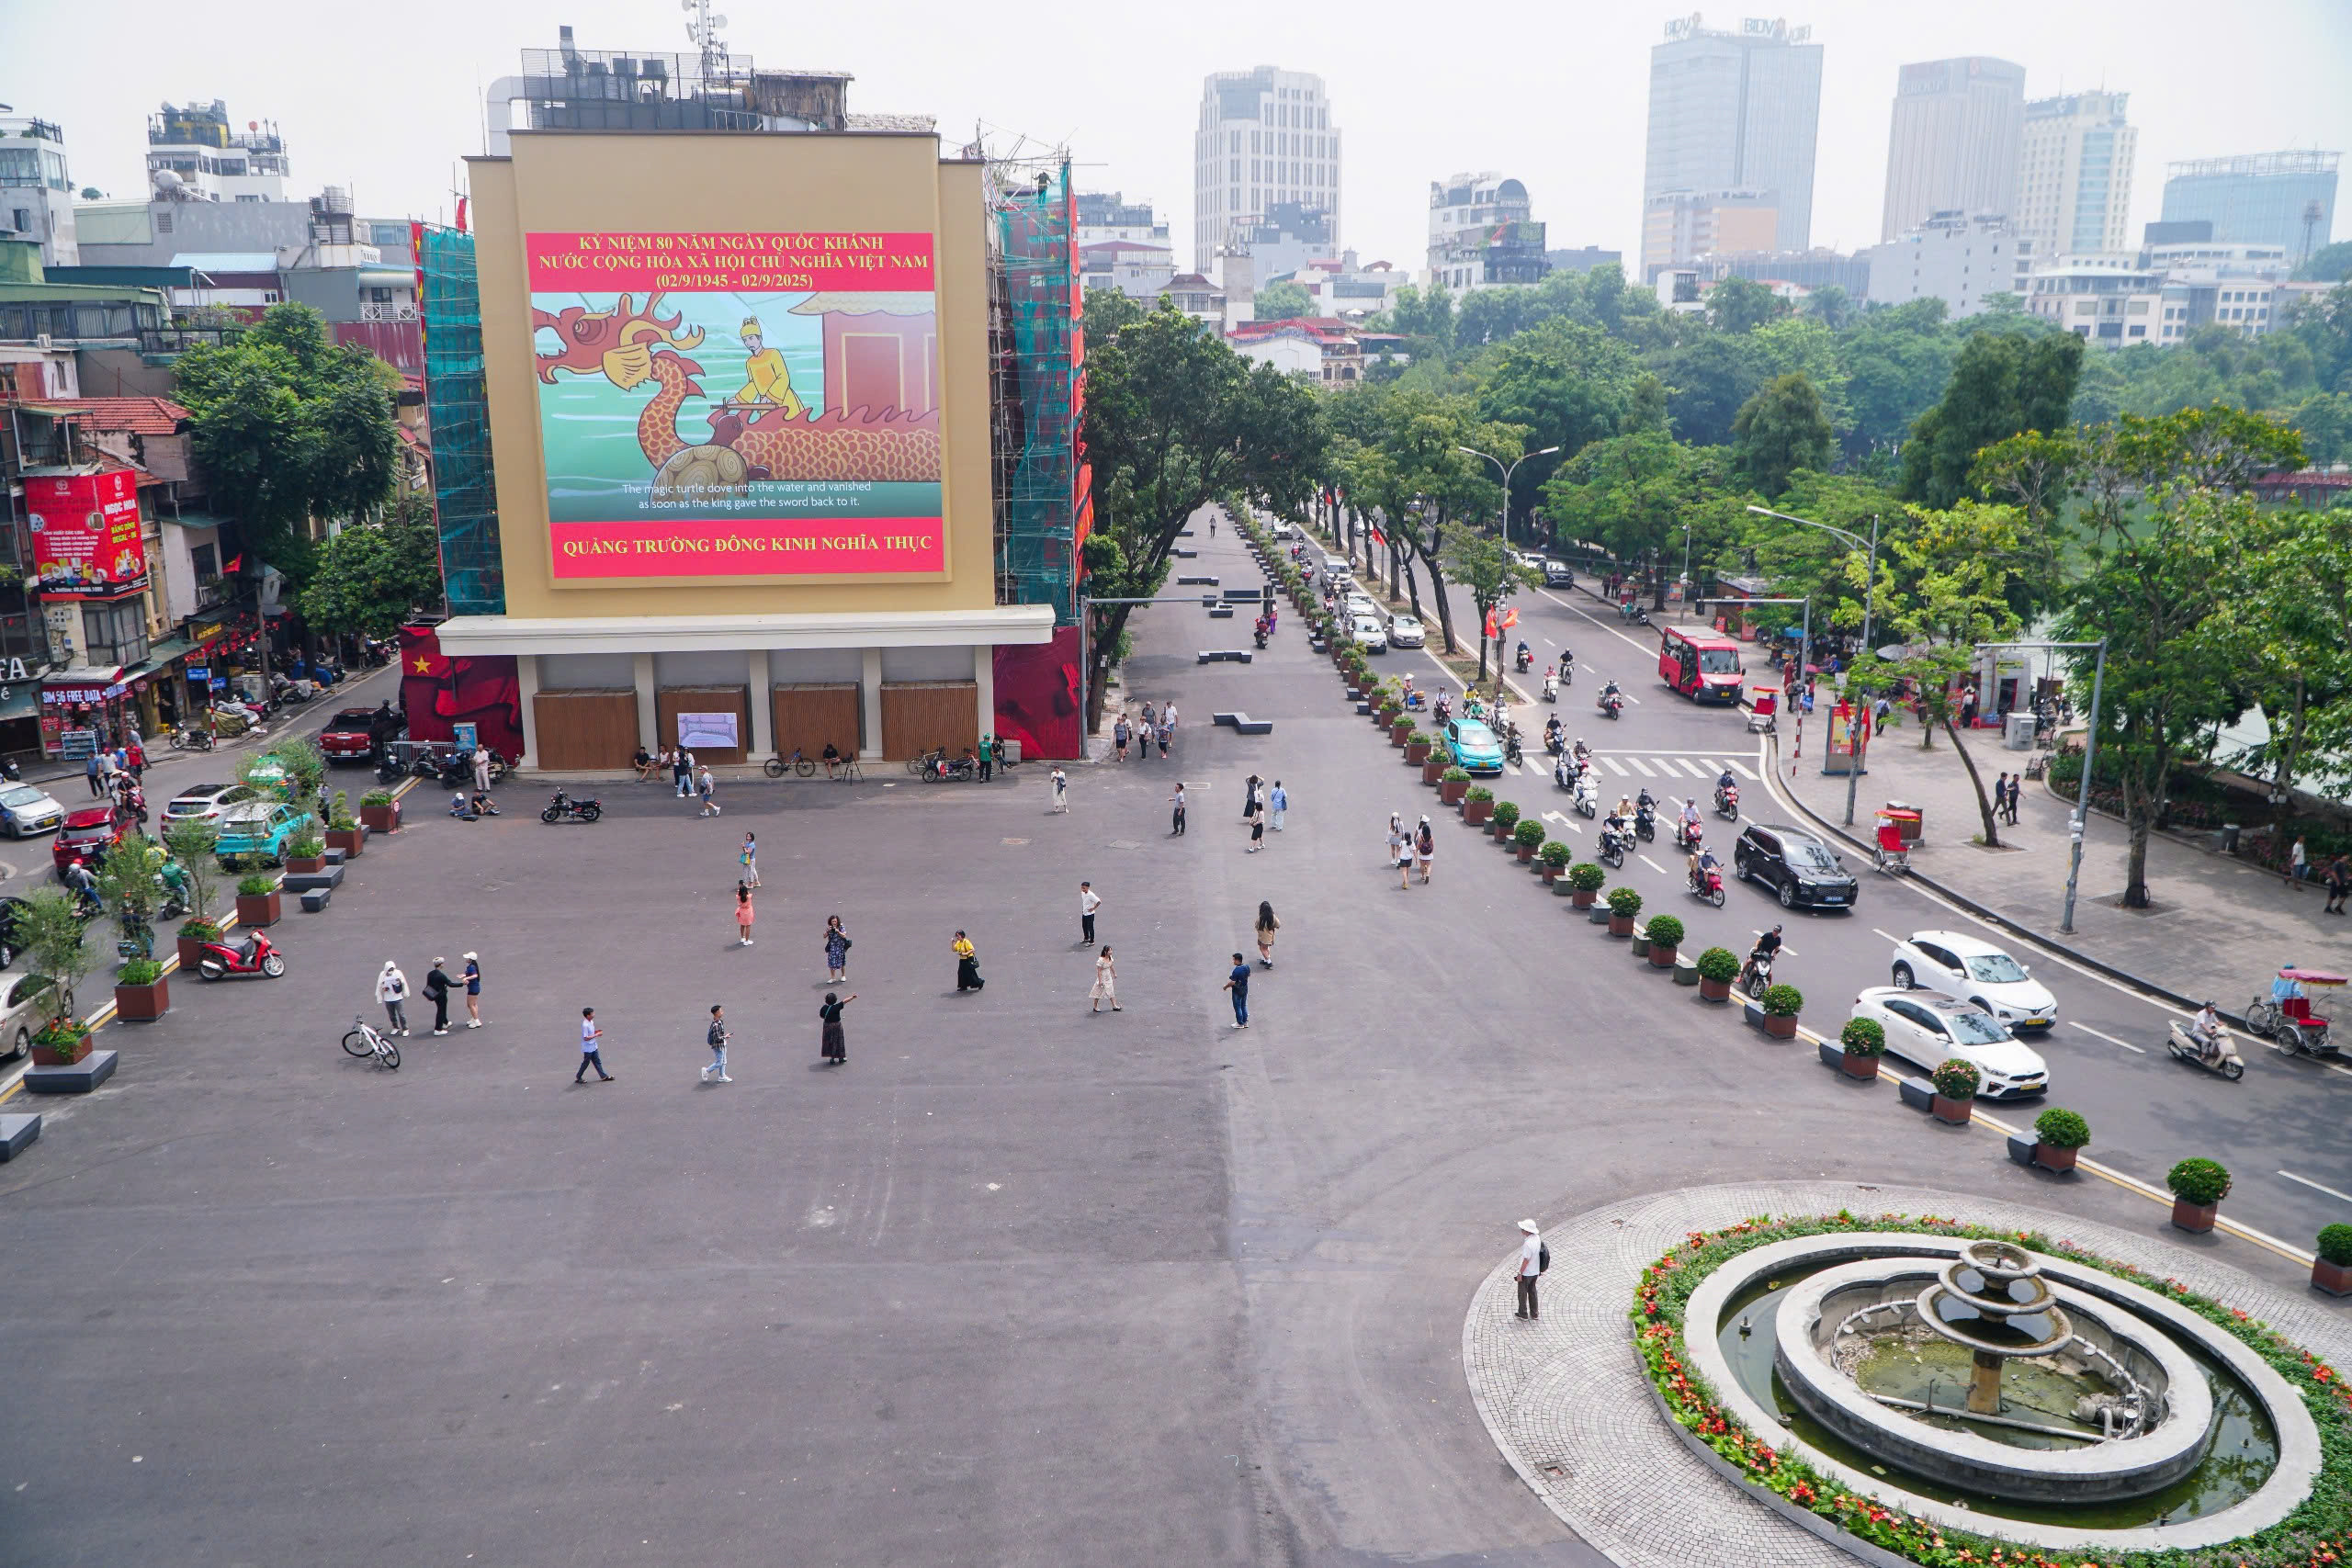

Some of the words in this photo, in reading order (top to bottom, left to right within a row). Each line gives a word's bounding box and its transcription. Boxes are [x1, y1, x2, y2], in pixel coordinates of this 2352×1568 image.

[1745, 17, 1775, 34] BIDV
[580, 231, 603, 249] KỶ
[608, 235, 652, 253] NIỆM
[656, 237, 673, 250] 80
[677, 234, 716, 250] NĂM
[720, 233, 766, 250] NGÀY
[772, 232, 820, 252] QUỐC
[824, 233, 883, 250] KHÁNH
[539, 253, 589, 269] NƯỚC
[594, 254, 641, 272] CỘNG
[647, 253, 683, 268] HÒA
[687, 253, 710, 268] XÃ
[715, 254, 745, 271] HỘI
[750, 253, 785, 268] CHỦ
[789, 253, 843, 268] NGHĨA
[848, 254, 886, 270] VIỆT
[891, 255, 928, 268] NAM
[656, 274, 728, 289] (02/9/1945
[741, 274, 813, 289] 02/9/2025)
[623, 484, 641, 493] The
[644, 484, 673, 496] magic
[676, 483, 705, 493] turtle
[707, 483, 732, 493] dove
[735, 482, 755, 492] into
[758, 482, 774, 492] the
[776, 483, 804, 492] water
[808, 481, 826, 491] and
[828, 480, 871, 491] vanished
[124, 499, 137, 511] HOA
[639, 501, 649, 509] as
[651, 500, 676, 509] soon
[679, 500, 689, 508] as
[692, 498, 708, 508] the
[711, 498, 732, 511] king
[734, 499, 756, 510] gave
[759, 497, 776, 507] the
[778, 496, 808, 507] sword
[811, 496, 833, 506] back
[836, 498, 847, 506] to
[850, 497, 860, 506] it.
[564, 538, 628, 558] QUẢNG
[633, 536, 709, 553] TRƯỜNG
[715, 535, 766, 552] ĐÔNG
[772, 538, 817, 551] KINH
[822, 534, 879, 550] NGHĨA
[884, 536, 932, 552] THỤC
[41, 691, 55, 703] SIM
[55, 691, 66, 702] 5G
[66, 690, 83, 702] FREE
[84, 690, 101, 701] DATA
